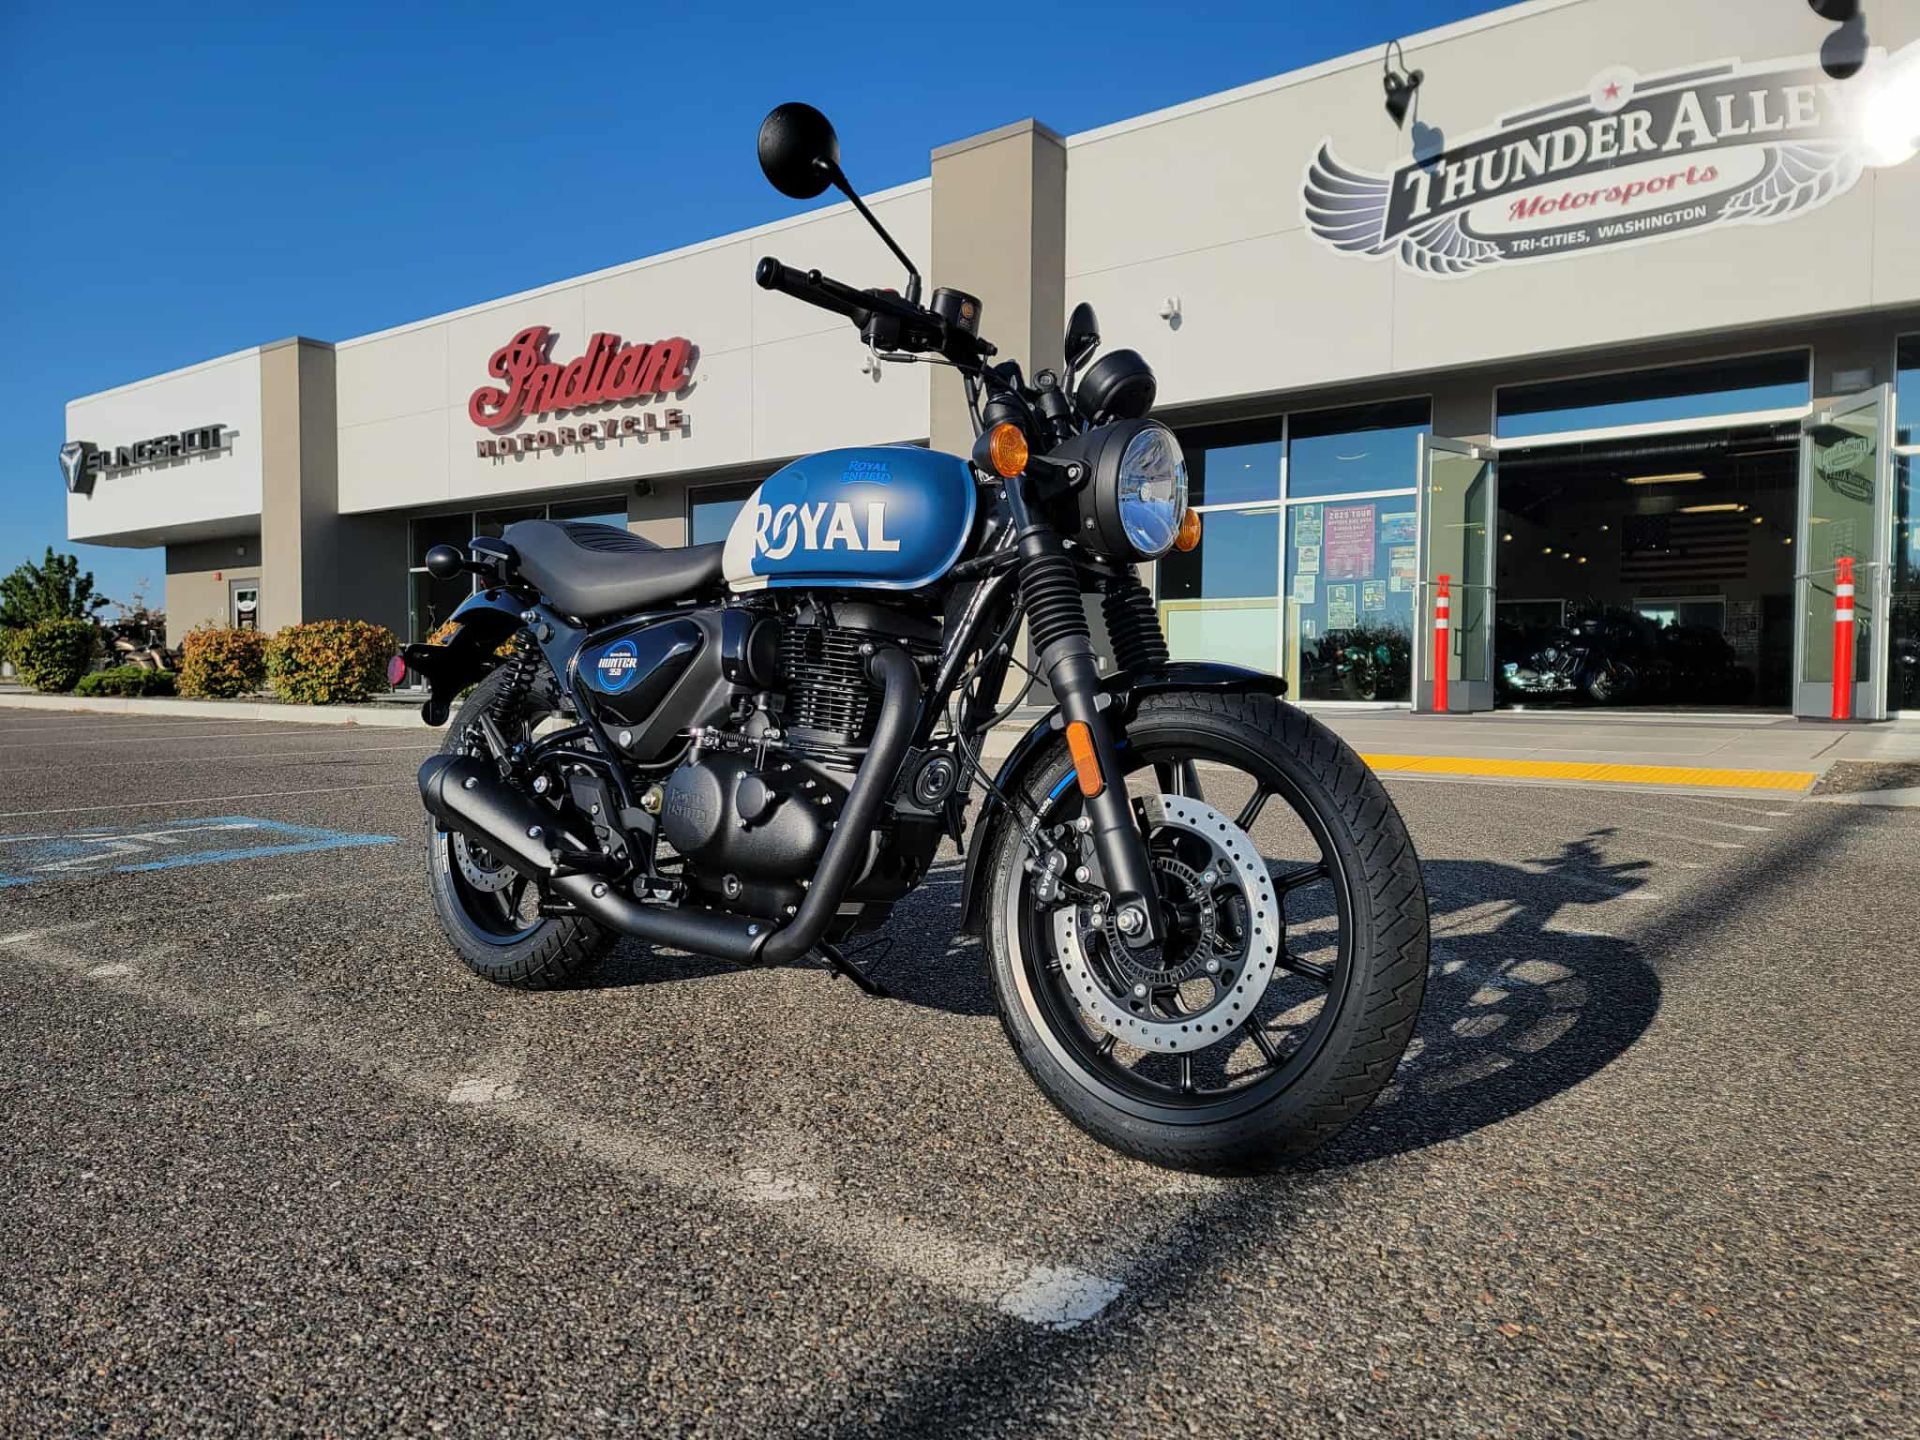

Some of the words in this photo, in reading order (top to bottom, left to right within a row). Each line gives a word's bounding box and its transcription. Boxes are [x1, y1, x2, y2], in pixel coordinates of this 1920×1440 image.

[1403, 107, 1658, 221] THUNDER
[1508, 165, 1719, 222] Motorsports
[1511, 229, 1591, 253] TRI-CITIES,
[1598, 205, 1707, 239] WASHINGTON
[469, 326, 692, 428] Indian
[477, 408, 685, 458] MOTORCYCLE
[848, 460, 889, 472] ROYAL
[753, 502, 901, 560] ROYAL
[598, 657, 638, 669] HUNTER
